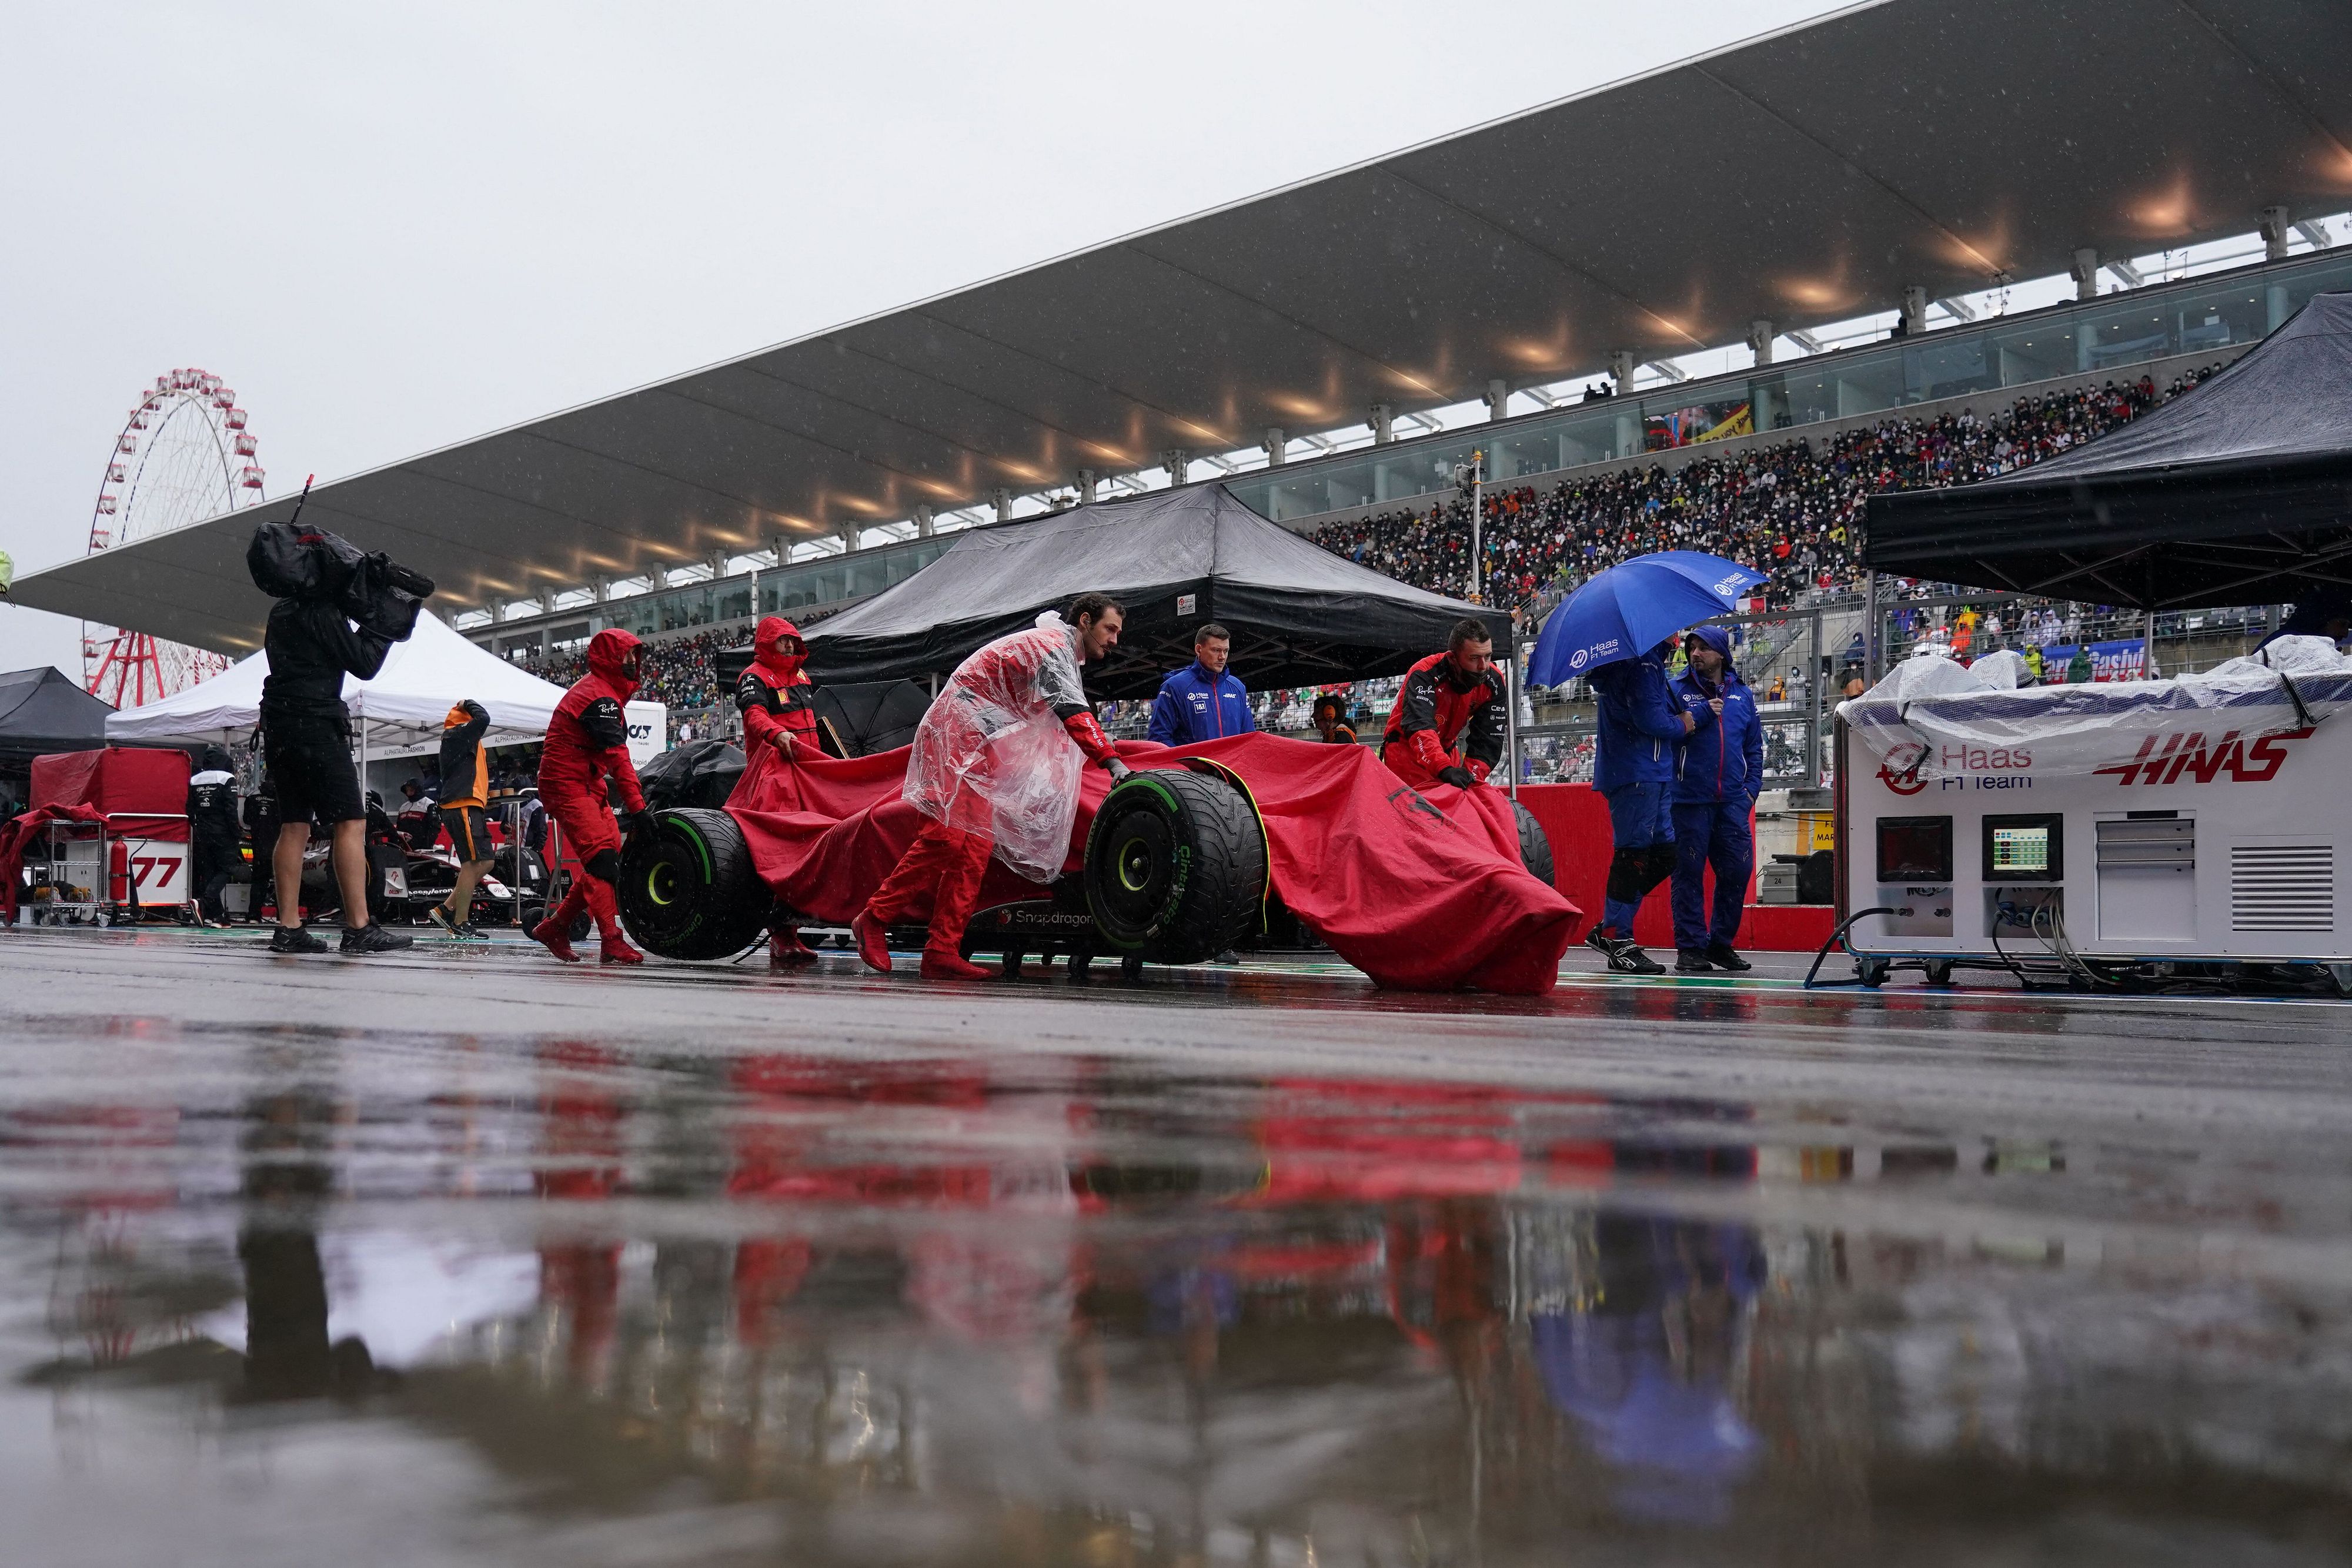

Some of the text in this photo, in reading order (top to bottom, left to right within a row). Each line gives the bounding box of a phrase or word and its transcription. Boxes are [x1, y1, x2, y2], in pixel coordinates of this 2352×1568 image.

[1720, 572, 1743, 586] Haas
[1590, 639, 1619, 655] Haas
[1599, 647, 1619, 657] Team
[1942, 744, 2032, 770] Haas
[2092, 727, 2317, 786] HAAS
[132, 857, 182, 888] 77
[1015, 910, 1094, 927] Snapdragon
